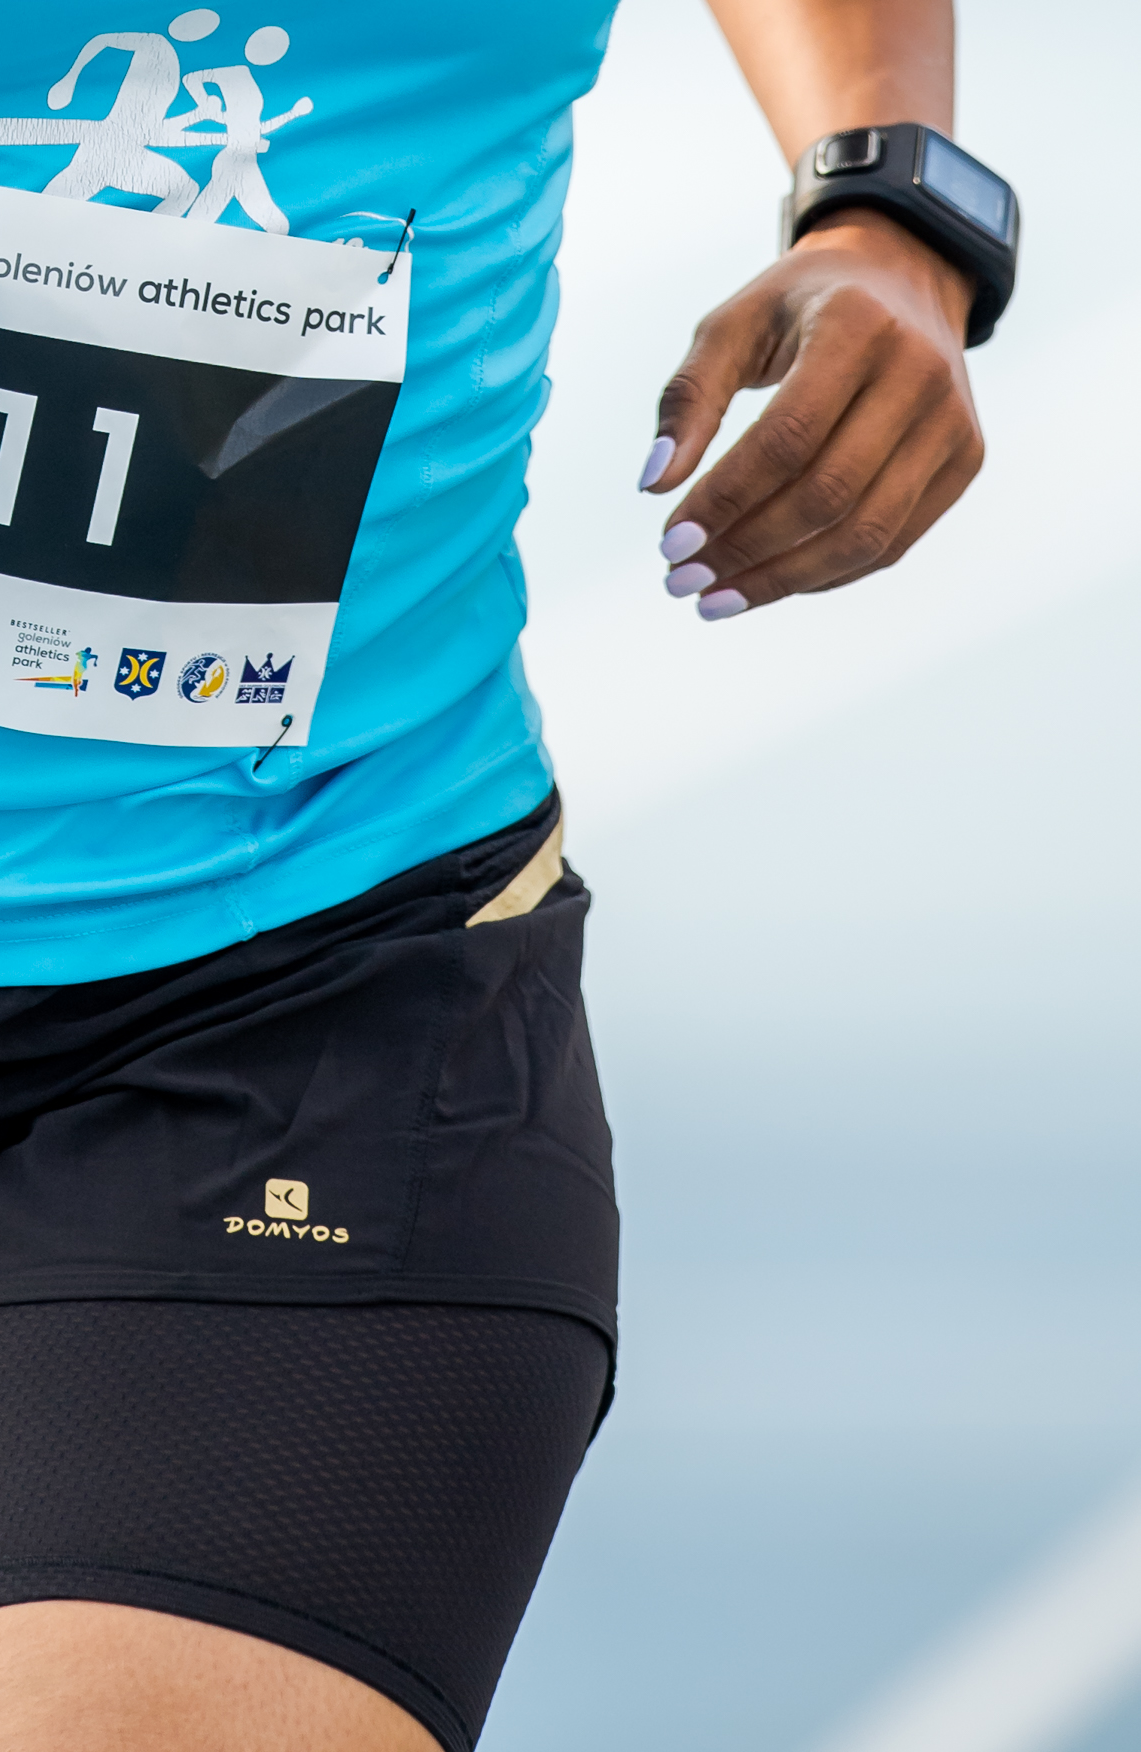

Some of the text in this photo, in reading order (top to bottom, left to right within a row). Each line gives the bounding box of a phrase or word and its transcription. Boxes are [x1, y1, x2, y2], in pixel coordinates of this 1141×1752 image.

[137, 277, 292, 325] athletics
[301, 306, 387, 336] park
[10, 619, 68, 636] BESTSELLER
[17, 632, 72, 648] goleniów
[14, 644, 70, 662] athletics
[11, 656, 43, 669] park
[223, 1216, 350, 1244] DOMYOS
